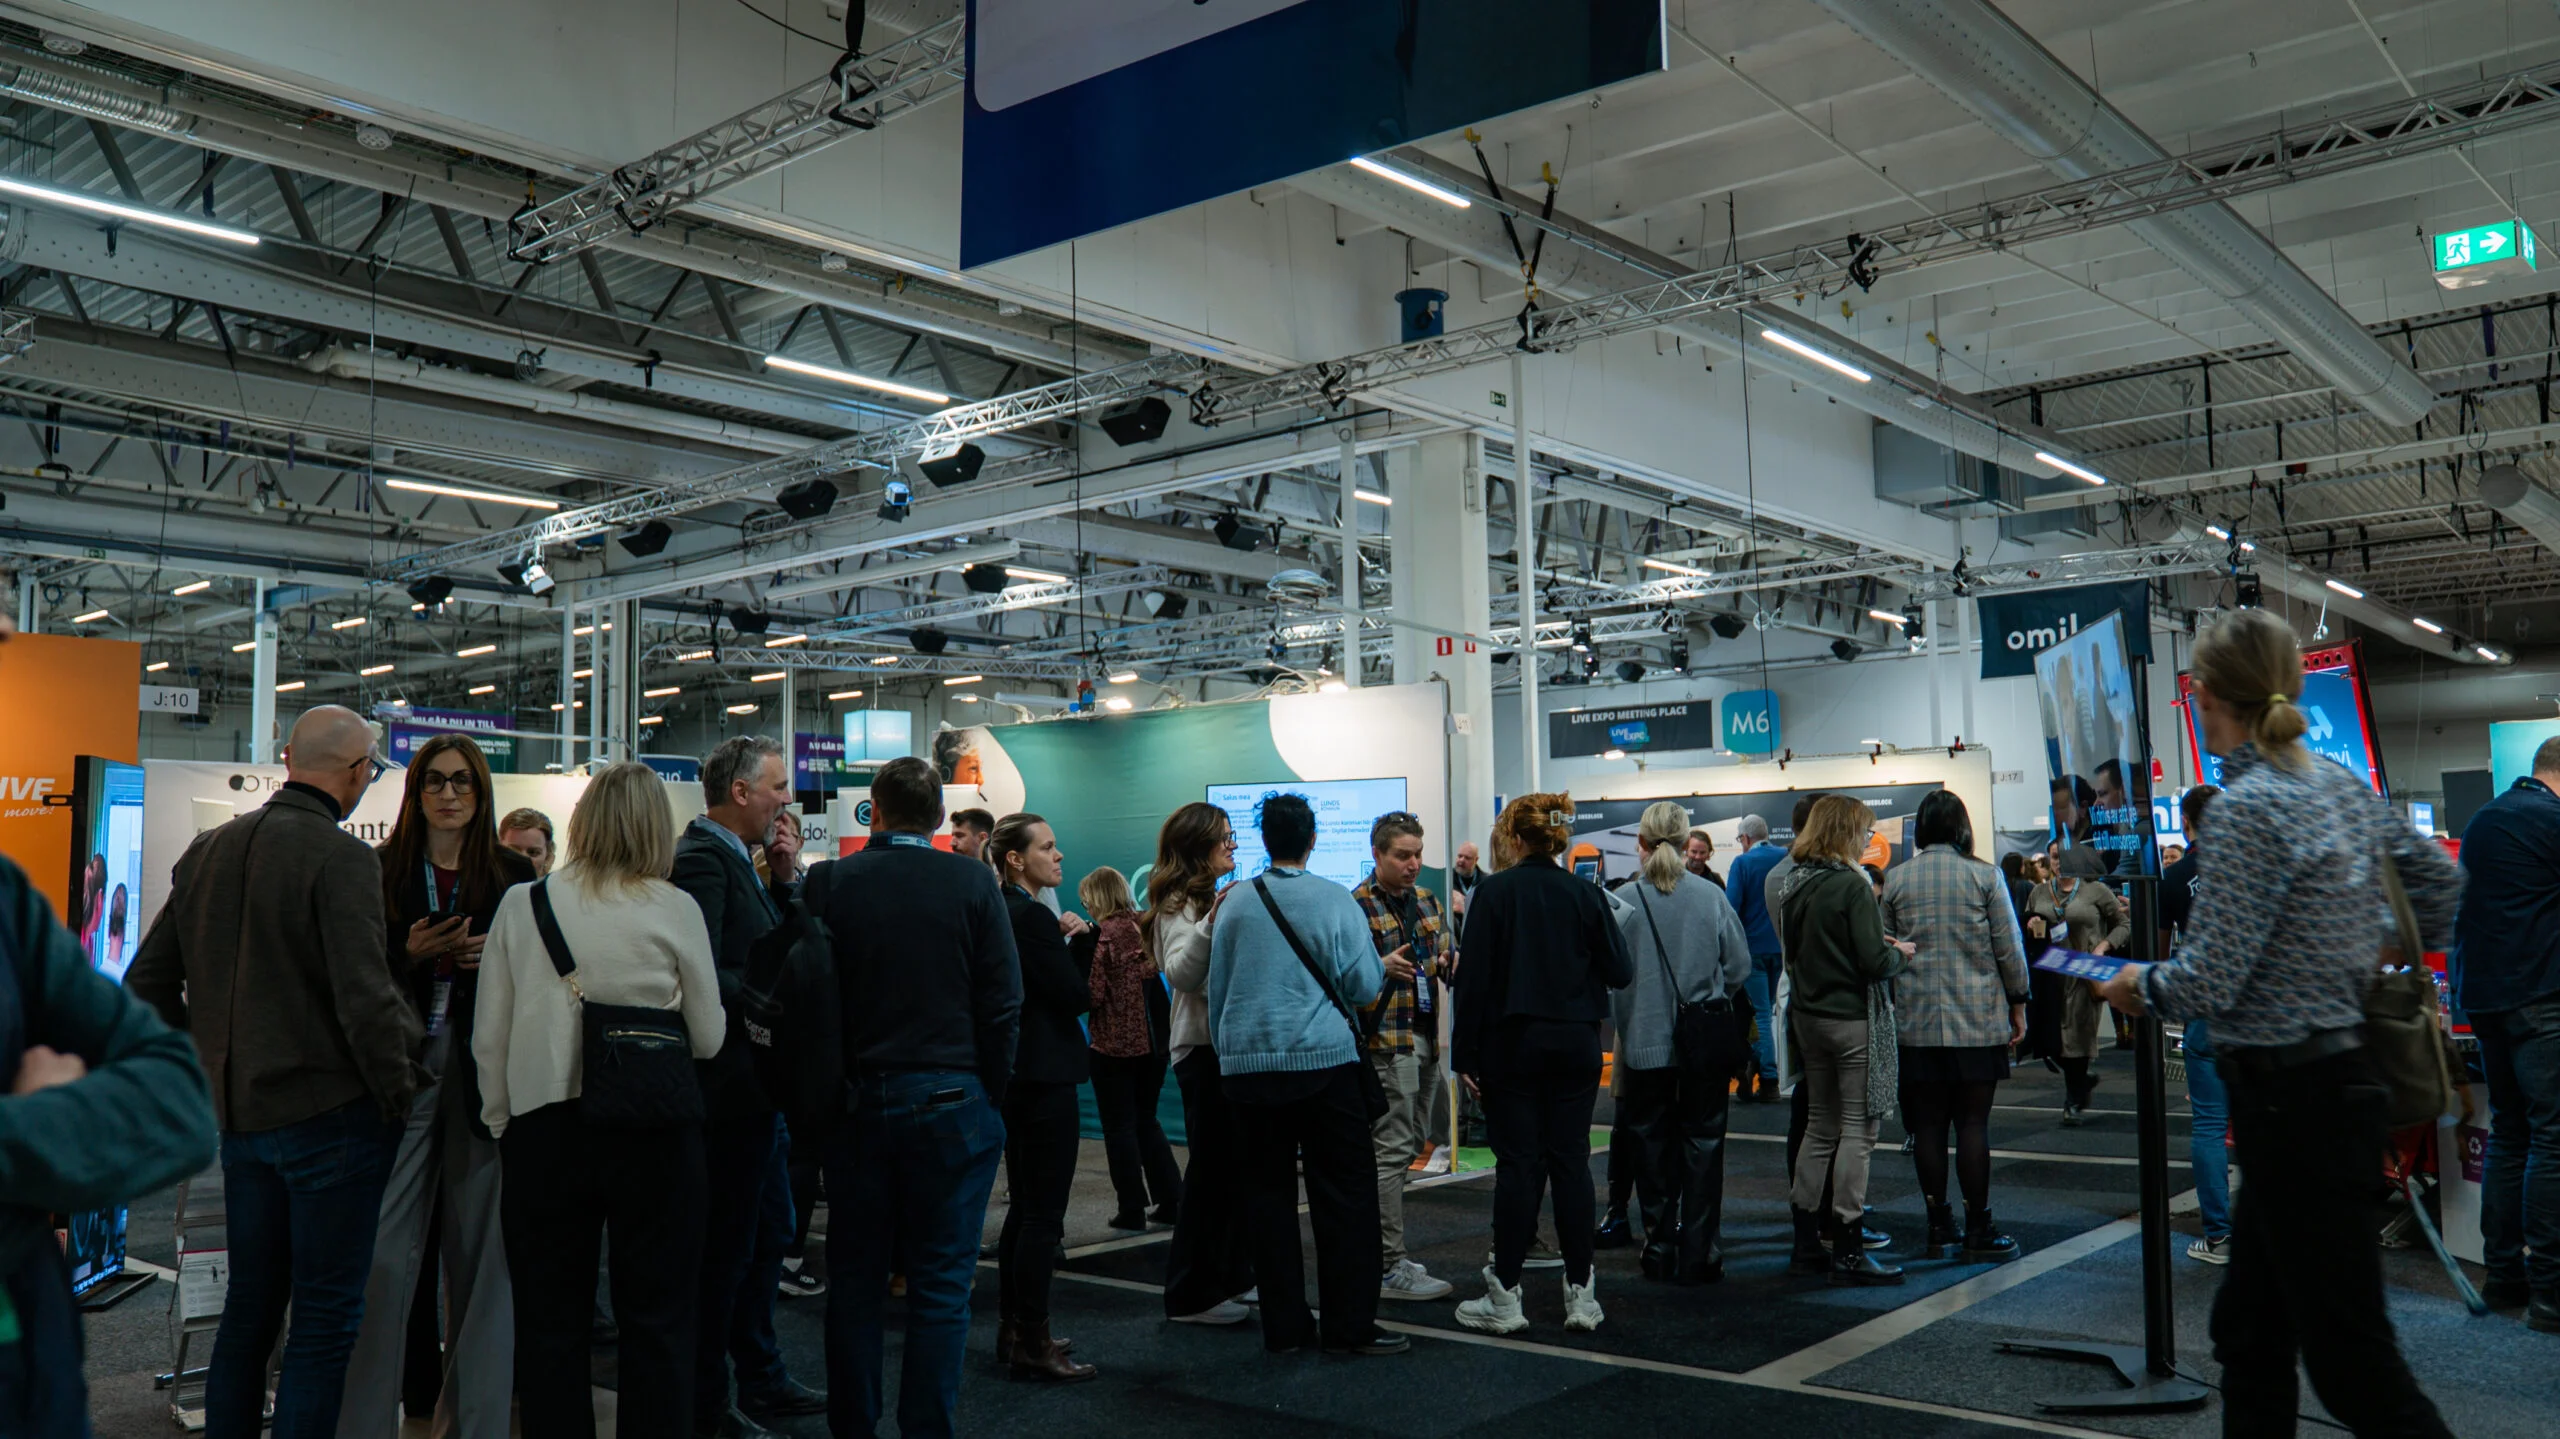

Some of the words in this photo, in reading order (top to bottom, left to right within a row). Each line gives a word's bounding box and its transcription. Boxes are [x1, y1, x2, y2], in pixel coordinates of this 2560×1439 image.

[153, 691, 189, 708] J:10
[1571, 714, 1591, 724] LIVE
[1592, 711, 1615, 722] EXPO
[1617, 708, 1657, 720] MEETING
[1658, 705, 1688, 717] PLACE
[1731, 709, 1770, 735] M6
[4, 805, 56, 819] move!
